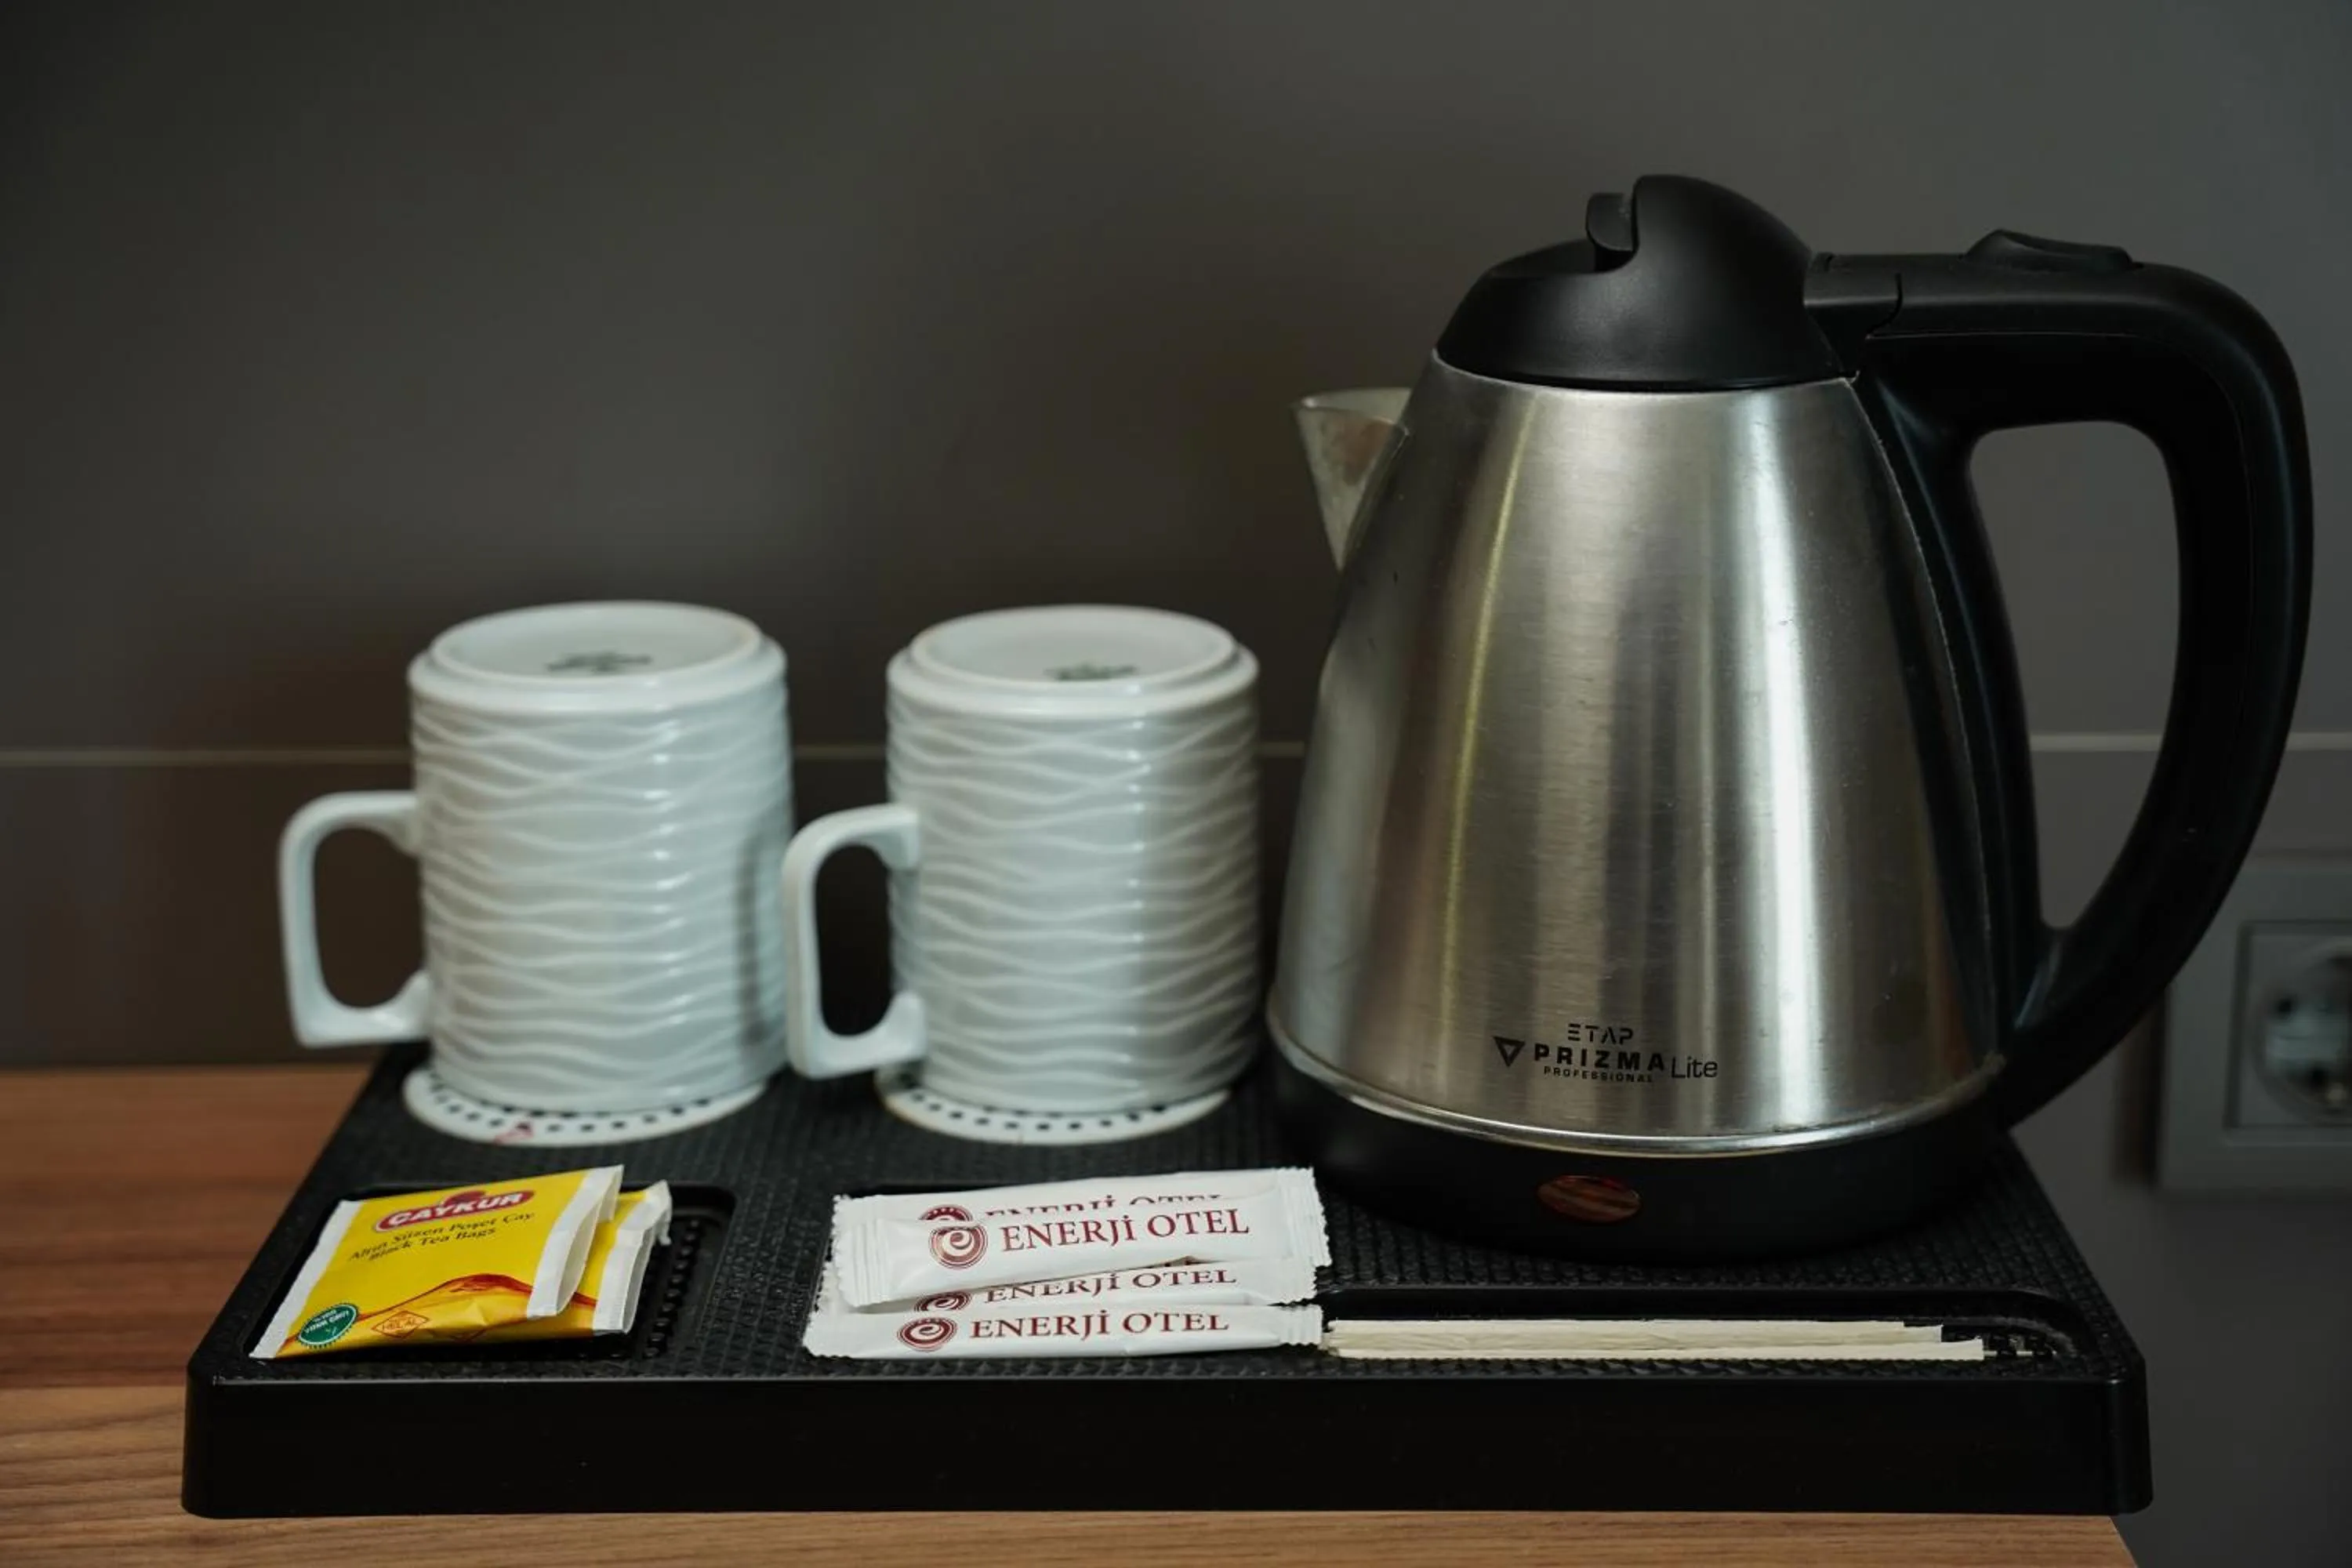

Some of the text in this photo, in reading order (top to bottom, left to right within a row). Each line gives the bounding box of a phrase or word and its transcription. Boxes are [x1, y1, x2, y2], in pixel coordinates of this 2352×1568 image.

[1568, 1022, 1634, 1044] ETAP
[1534, 1044, 1719, 1079] PRIZMA Lite
[1544, 1065, 1653, 1083] PROFESSIONAL
[1146, 1207, 1250, 1238] OTEL
[421, 1234, 451, 1247] Tea
[456, 1228, 497, 1241] Bags
[1131, 1269, 1237, 1289] OTEL
[1121, 1312, 1230, 1334] OTEL
